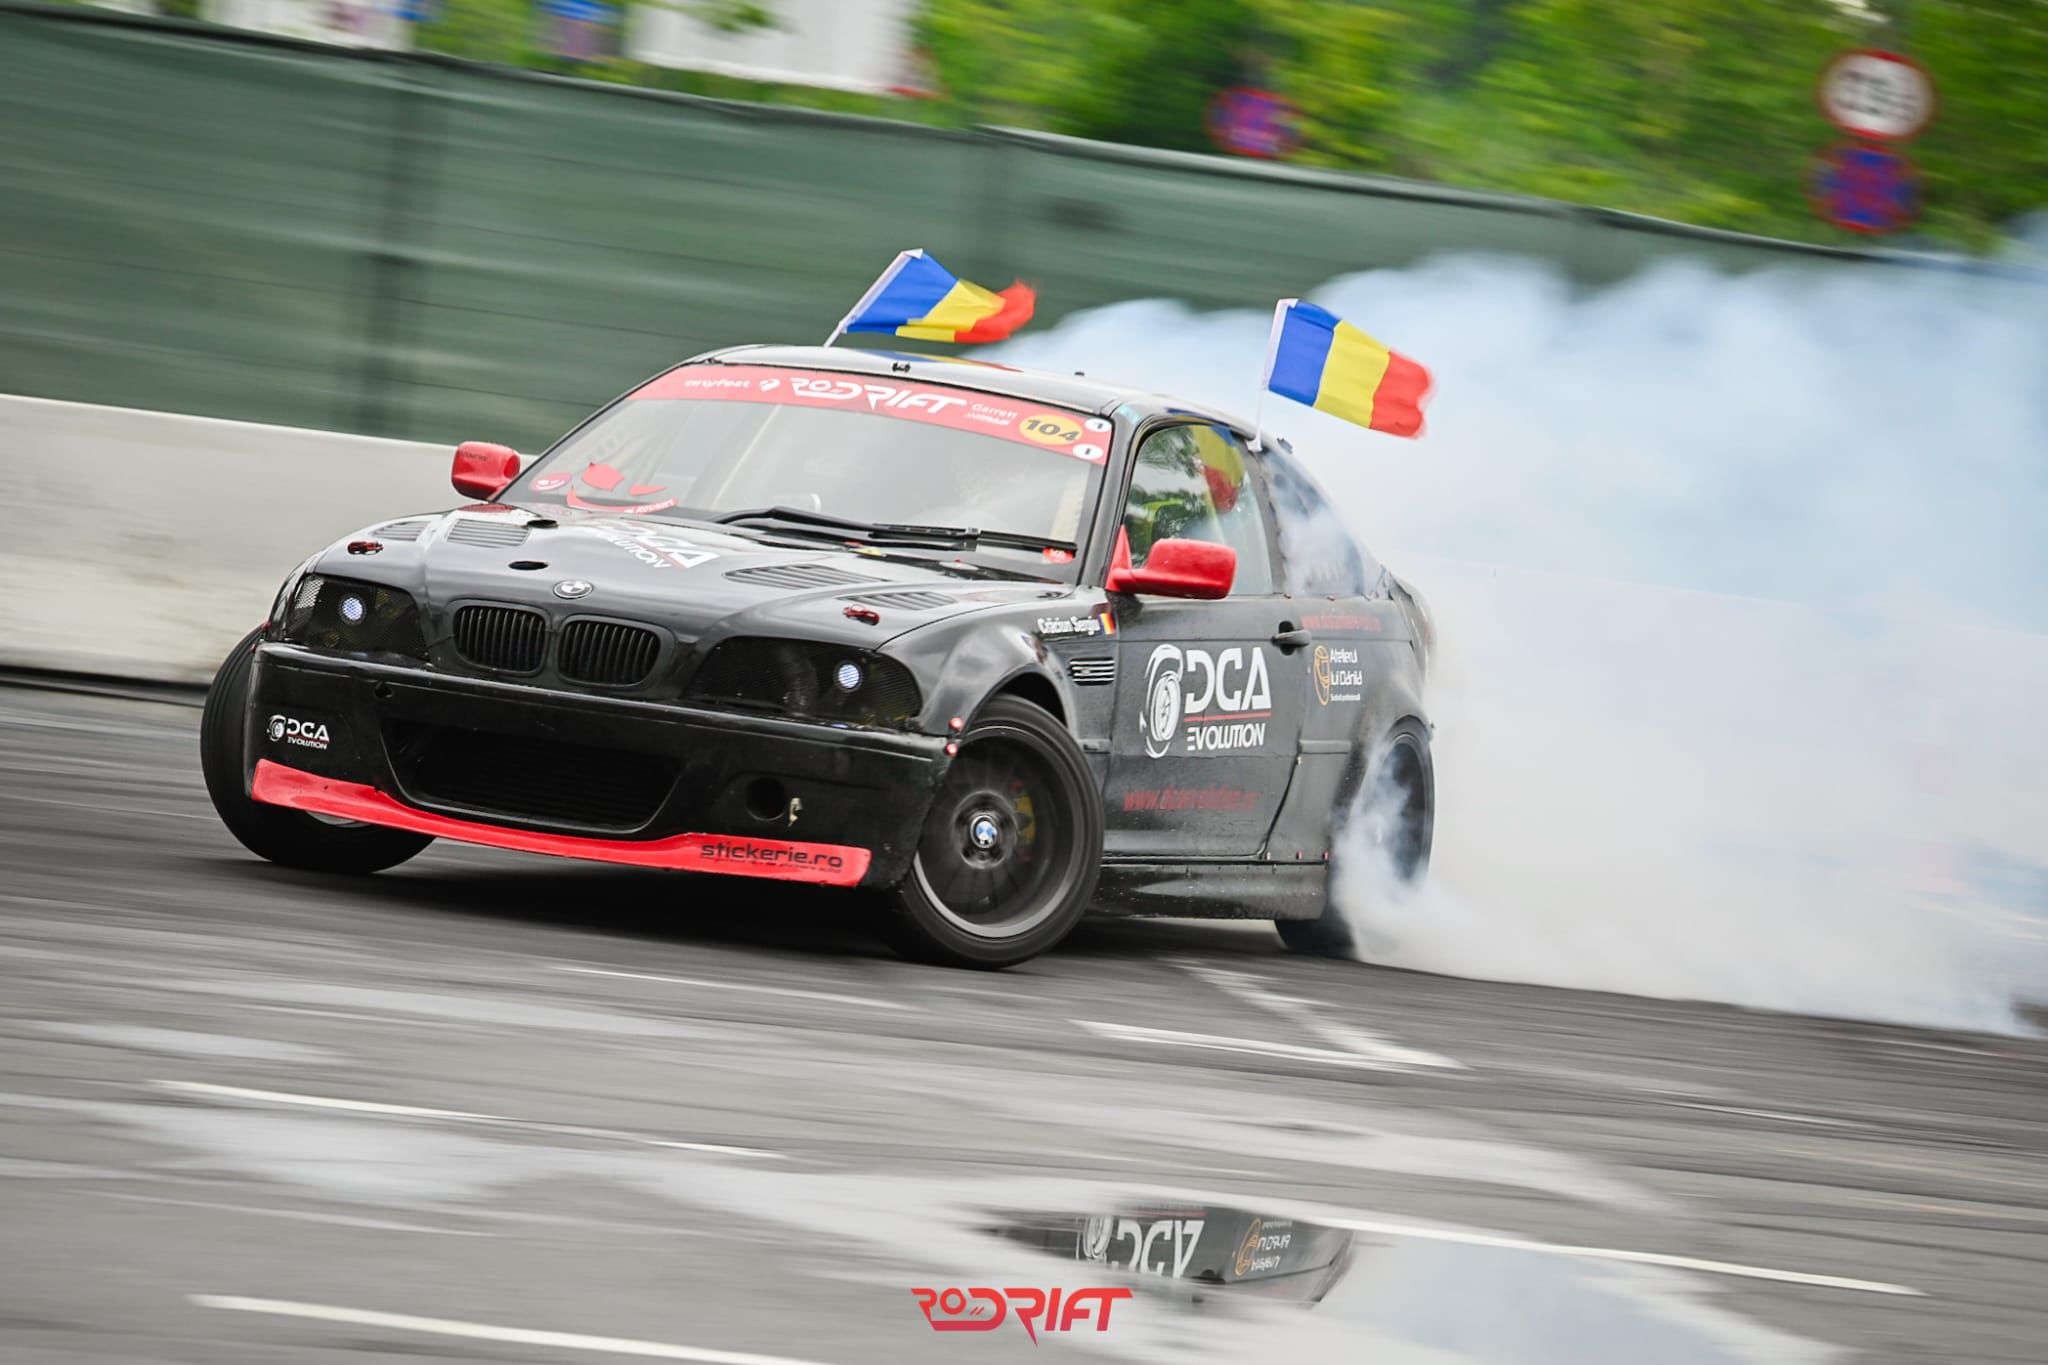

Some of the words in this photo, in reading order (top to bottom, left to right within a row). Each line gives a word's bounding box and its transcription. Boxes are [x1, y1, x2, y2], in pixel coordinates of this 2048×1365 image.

[790, 377, 967, 413] RODRIFT
[971, 403, 1018, 419] Garrett
[1026, 419, 1080, 441] 104
[1184, 647, 1272, 714] DCA
[286, 718, 330, 742] DCA
[1187, 723, 1266, 751] EVOLUTION
[287, 736, 327, 750] EVOLUTION
[701, 842, 843, 868] stickerie.ro
